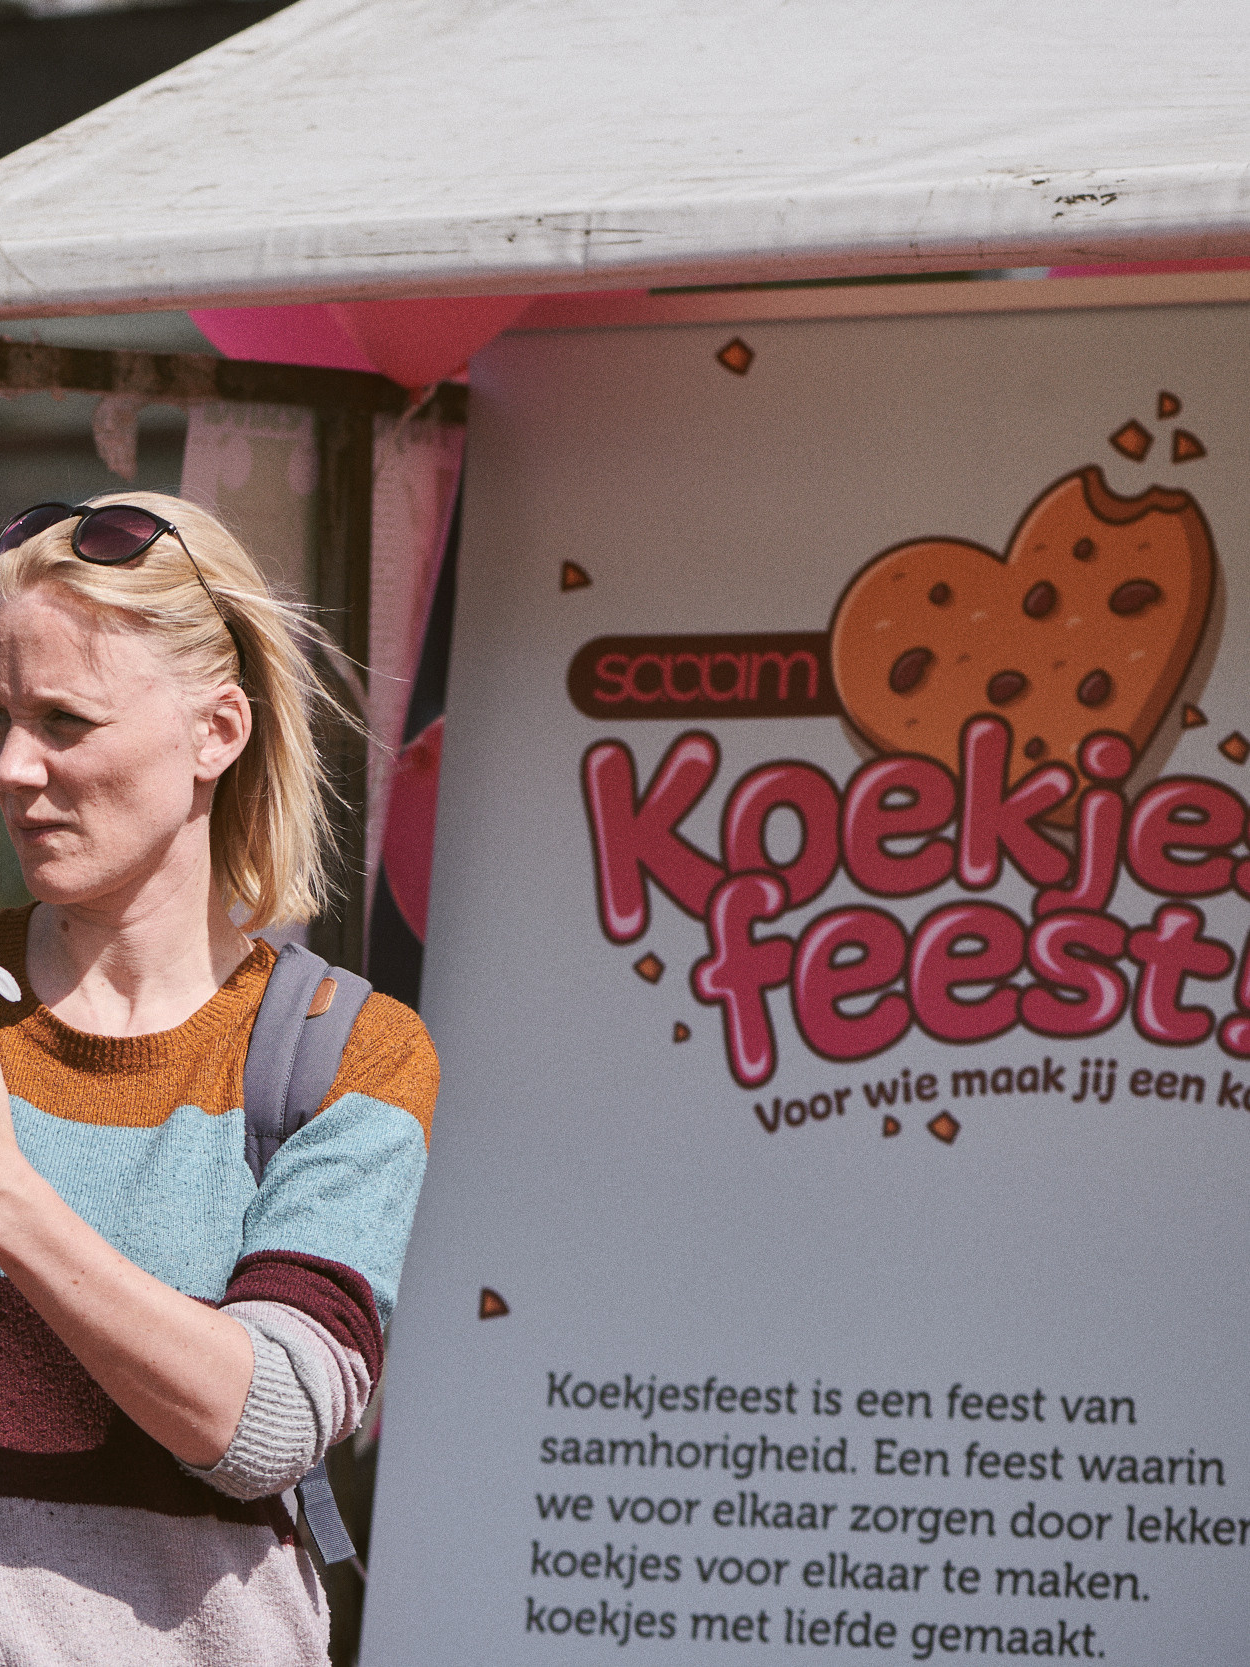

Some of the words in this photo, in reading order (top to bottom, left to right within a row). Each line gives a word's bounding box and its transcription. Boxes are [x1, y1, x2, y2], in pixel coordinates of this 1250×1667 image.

[593, 650, 819, 703] saaam
[753, 1087, 852, 1135] Voor
[863, 1068, 939, 1109] wie
[951, 1056, 1066, 1098] maak
[1071, 1057, 1120, 1105] jij
[1128, 1067, 1207, 1104] een
[546, 1371, 798, 1420] Koekjesfeest
[812, 1379, 842, 1417] is
[855, 1389, 932, 1419] een
[947, 1383, 1046, 1423] feest
[1060, 1395, 1137, 1425] van
[540, 1430, 858, 1480] saamhorigheid.
[874, 1438, 950, 1477] Een
[964, 1441, 1064, 1481] feest
[1077, 1448, 1226, 1487] waarin
[535, 1494, 594, 1522] we
[607, 1496, 701, 1525] voor
[712, 1491, 837, 1530] elkaar
[849, 1504, 996, 1545] zorgen
[1009, 1501, 1113, 1541] door
[531, 1540, 682, 1590] koekjes
[695, 1557, 789, 1586] voor
[802, 1551, 930, 1592] elkaar
[942, 1560, 981, 1595] te
[995, 1562, 1150, 1602] maken.
[525, 1596, 676, 1647] koekjes
[690, 1610, 770, 1644] met
[784, 1607, 898, 1650] liefde
[910, 1619, 1105, 1661] gemaakt.
